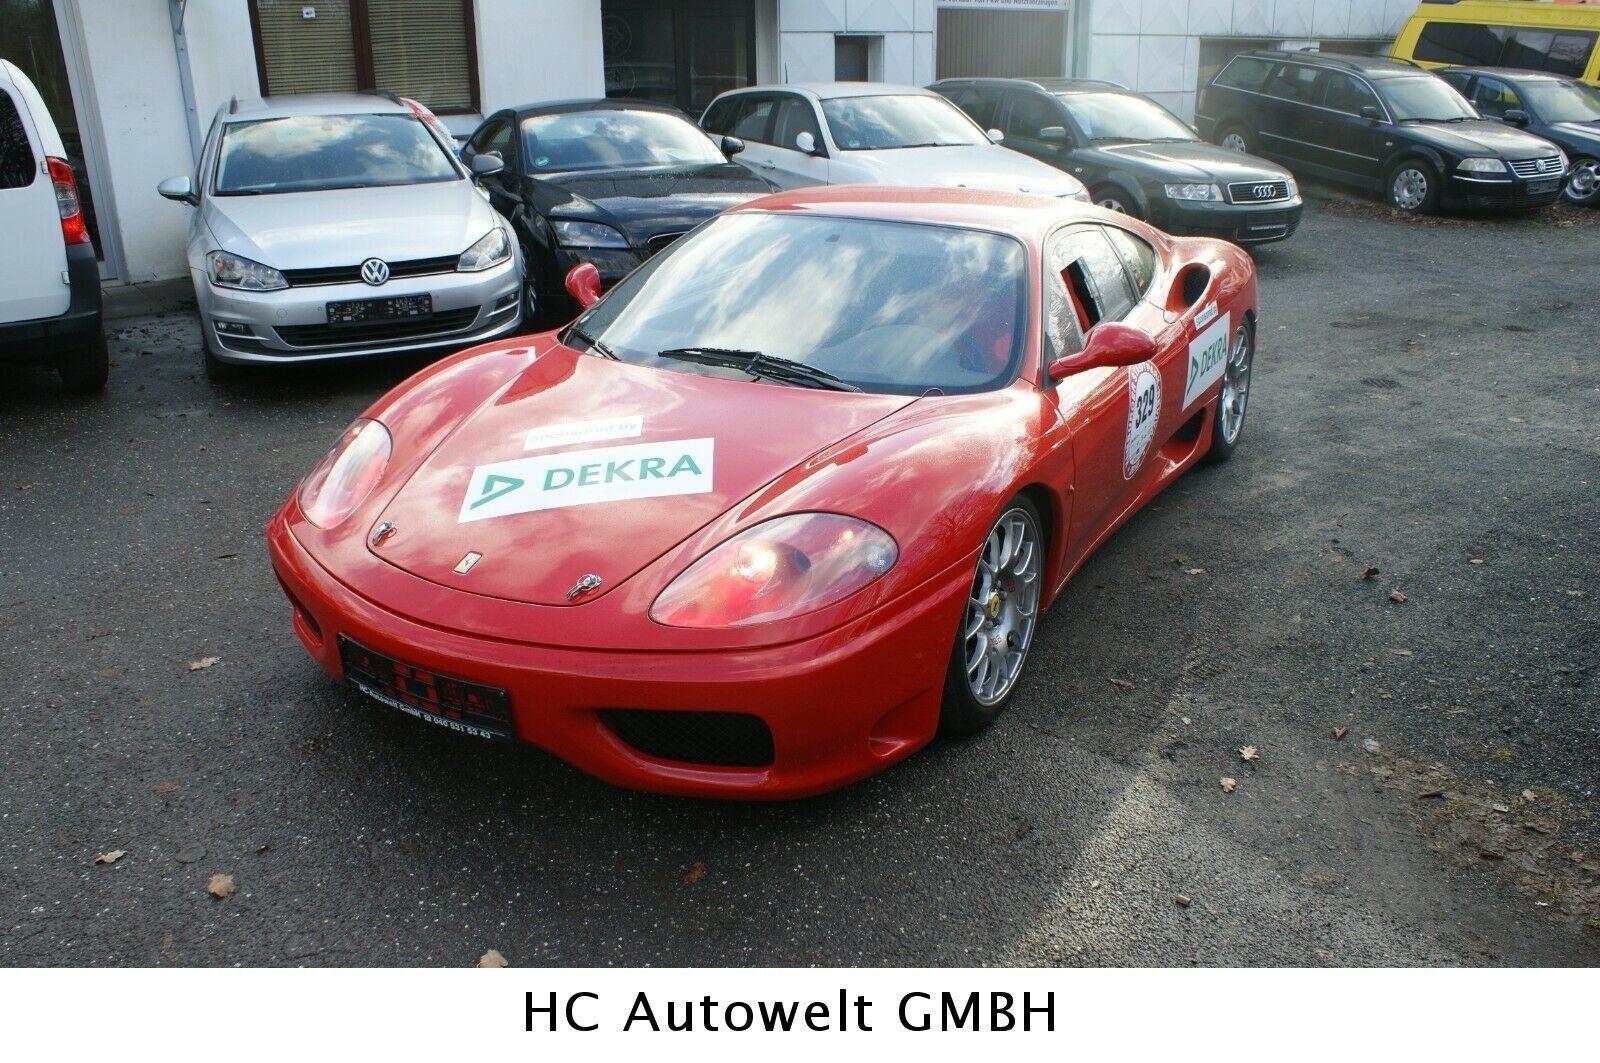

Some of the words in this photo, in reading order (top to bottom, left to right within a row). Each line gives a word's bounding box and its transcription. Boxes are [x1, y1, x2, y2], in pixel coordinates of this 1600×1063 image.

[1200, 333, 1227, 377] DEKRA
[1135, 384, 1155, 429] 329
[542, 455, 702, 492] DEKRA
